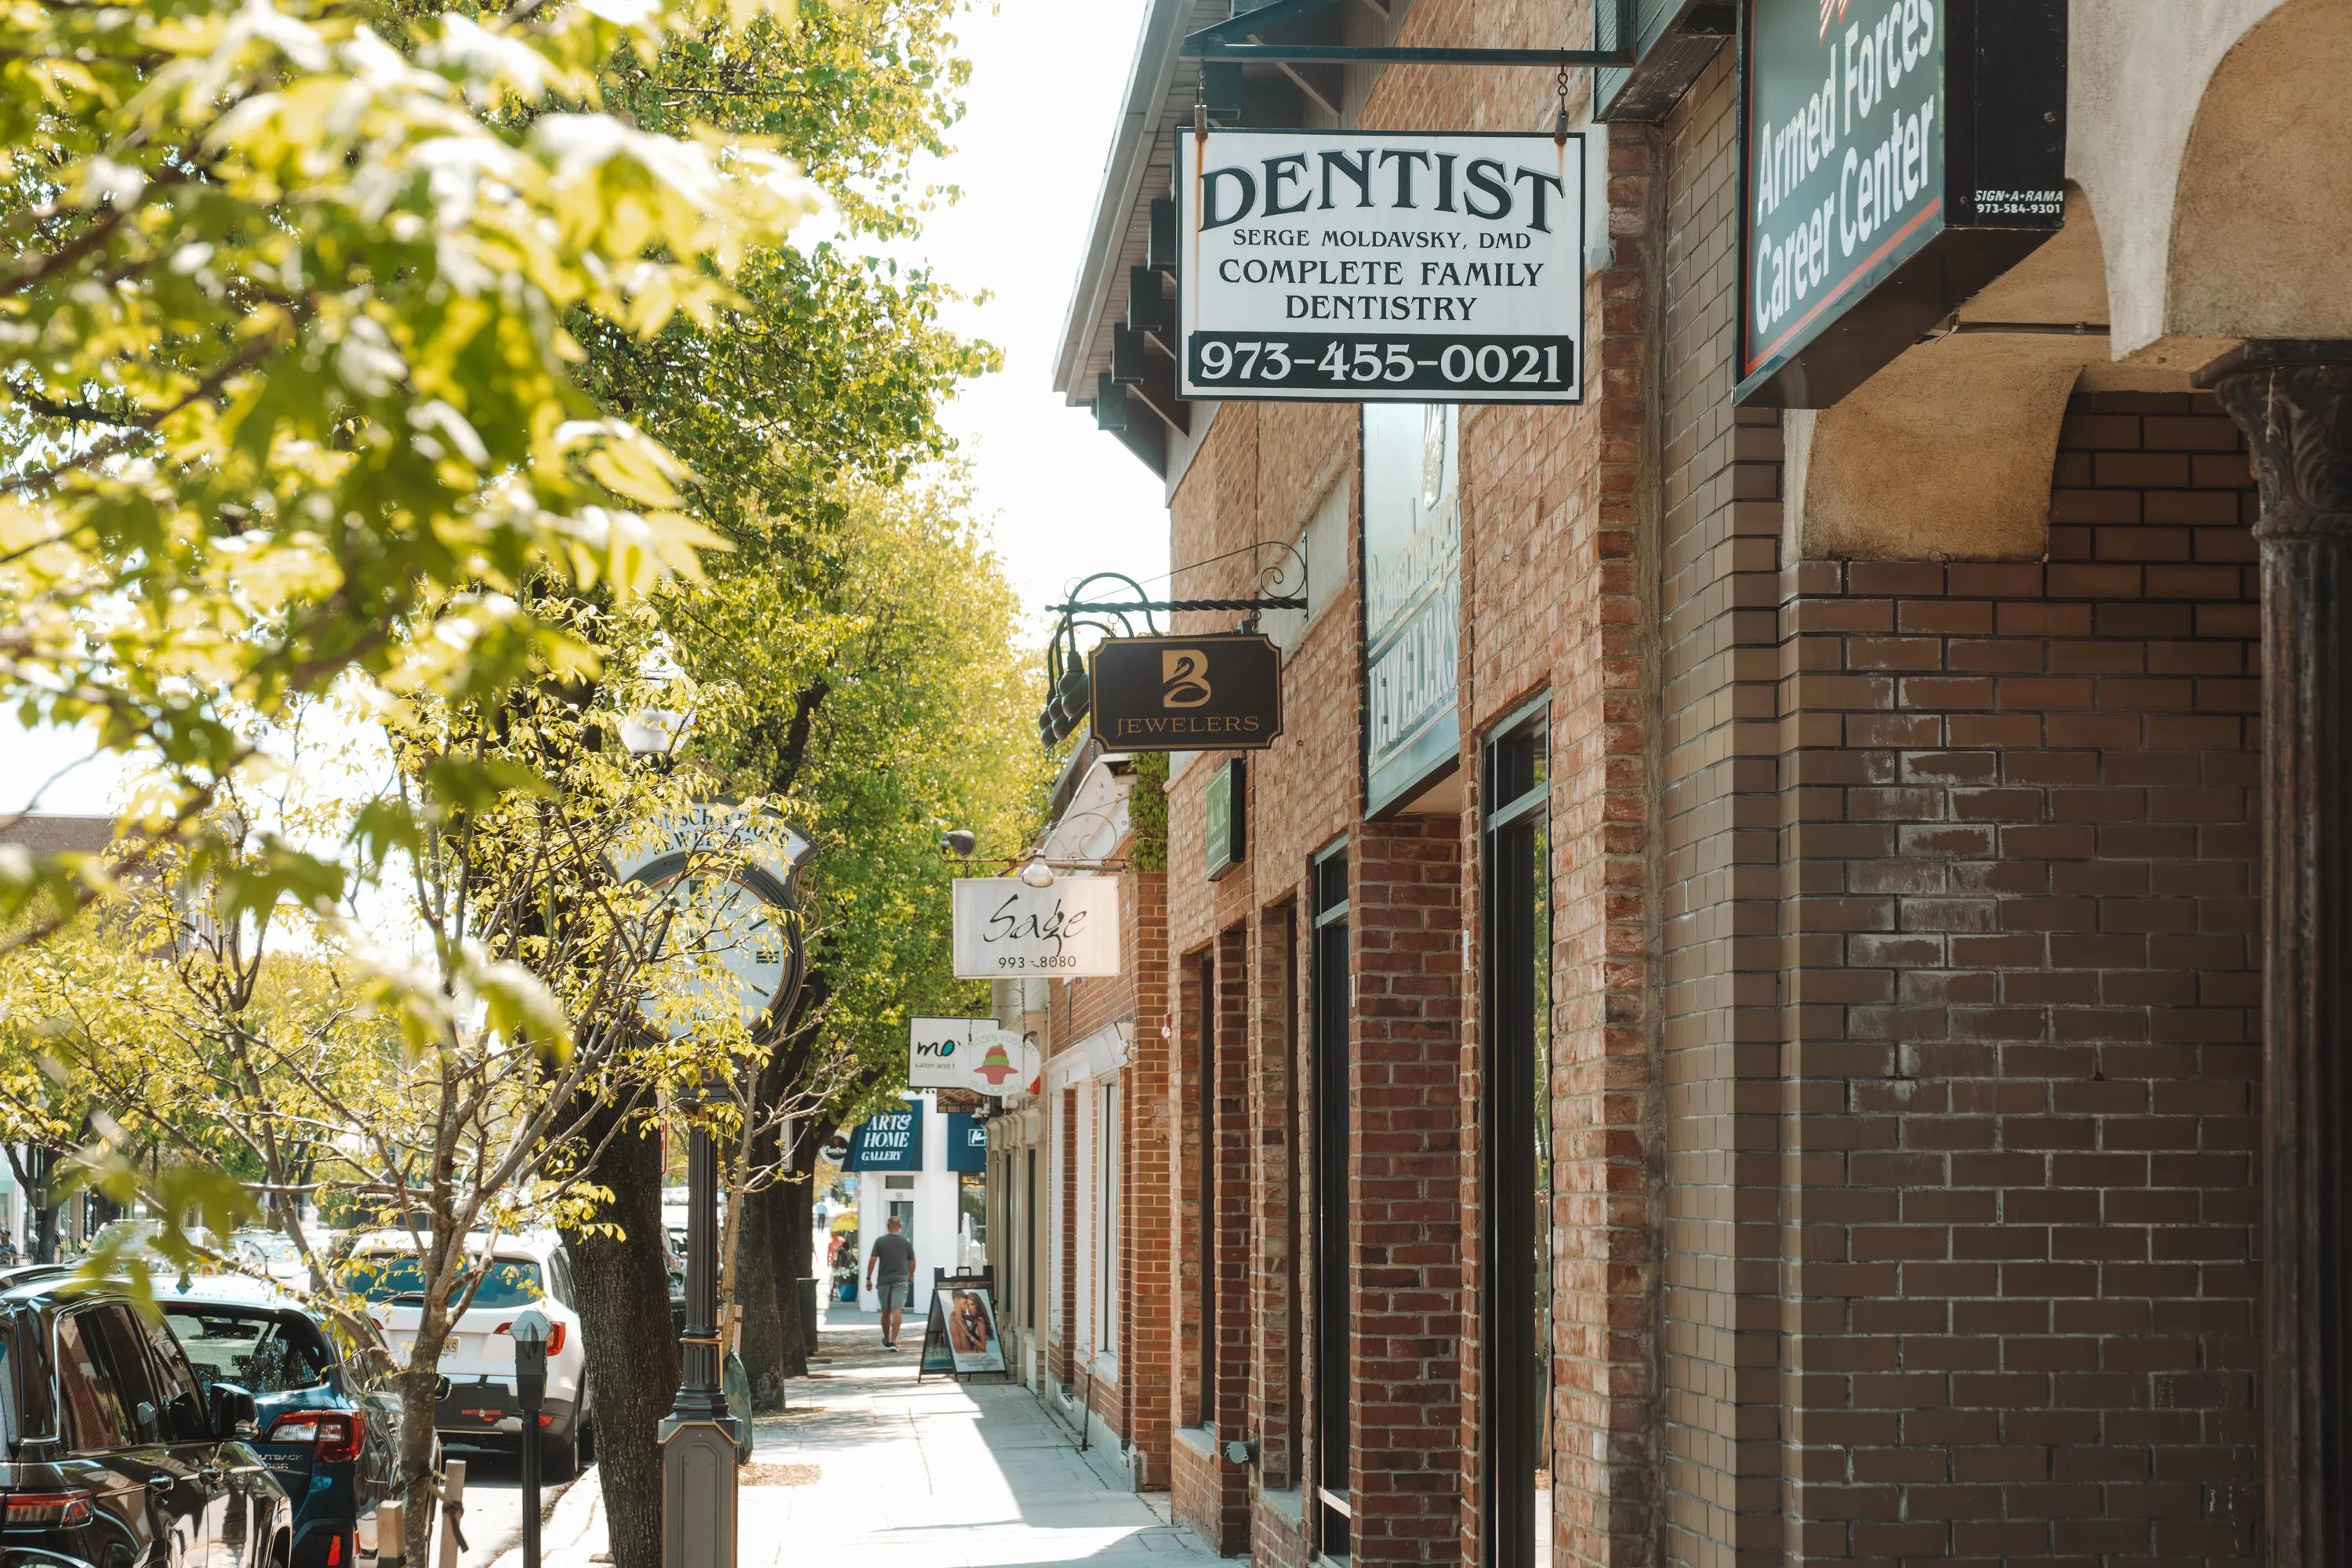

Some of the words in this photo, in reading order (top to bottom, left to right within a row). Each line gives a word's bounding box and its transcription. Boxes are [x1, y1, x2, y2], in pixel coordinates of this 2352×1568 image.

[1757, 44, 1836, 227] Armed
[1844, 0, 1934, 136] Forces
[1198, 147, 1566, 234] DENTIST
[1756, 192, 1835, 334] Career
[1840, 95, 1934, 257] Center
[1976, 204, 2060, 213] 973-584-9301
[1233, 229, 1310, 246] SERGE
[1322, 230, 1468, 250] MOLDAVSKY,
[1479, 232, 1531, 249] DMD
[1219, 259, 1404, 286] COMPLETE
[1421, 263, 1544, 287] FAMILY
[1285, 295, 1477, 321] DENTISTRY
[1200, 340, 1562, 384] 973-455-0021
[1116, 716, 1259, 738] JEWELERS
[983, 893, 1087, 957] Sage
[866, 1114, 912, 1131] ART&
[863, 1131, 909, 1147] HOME
[861, 1150, 903, 1160] GALLERY
